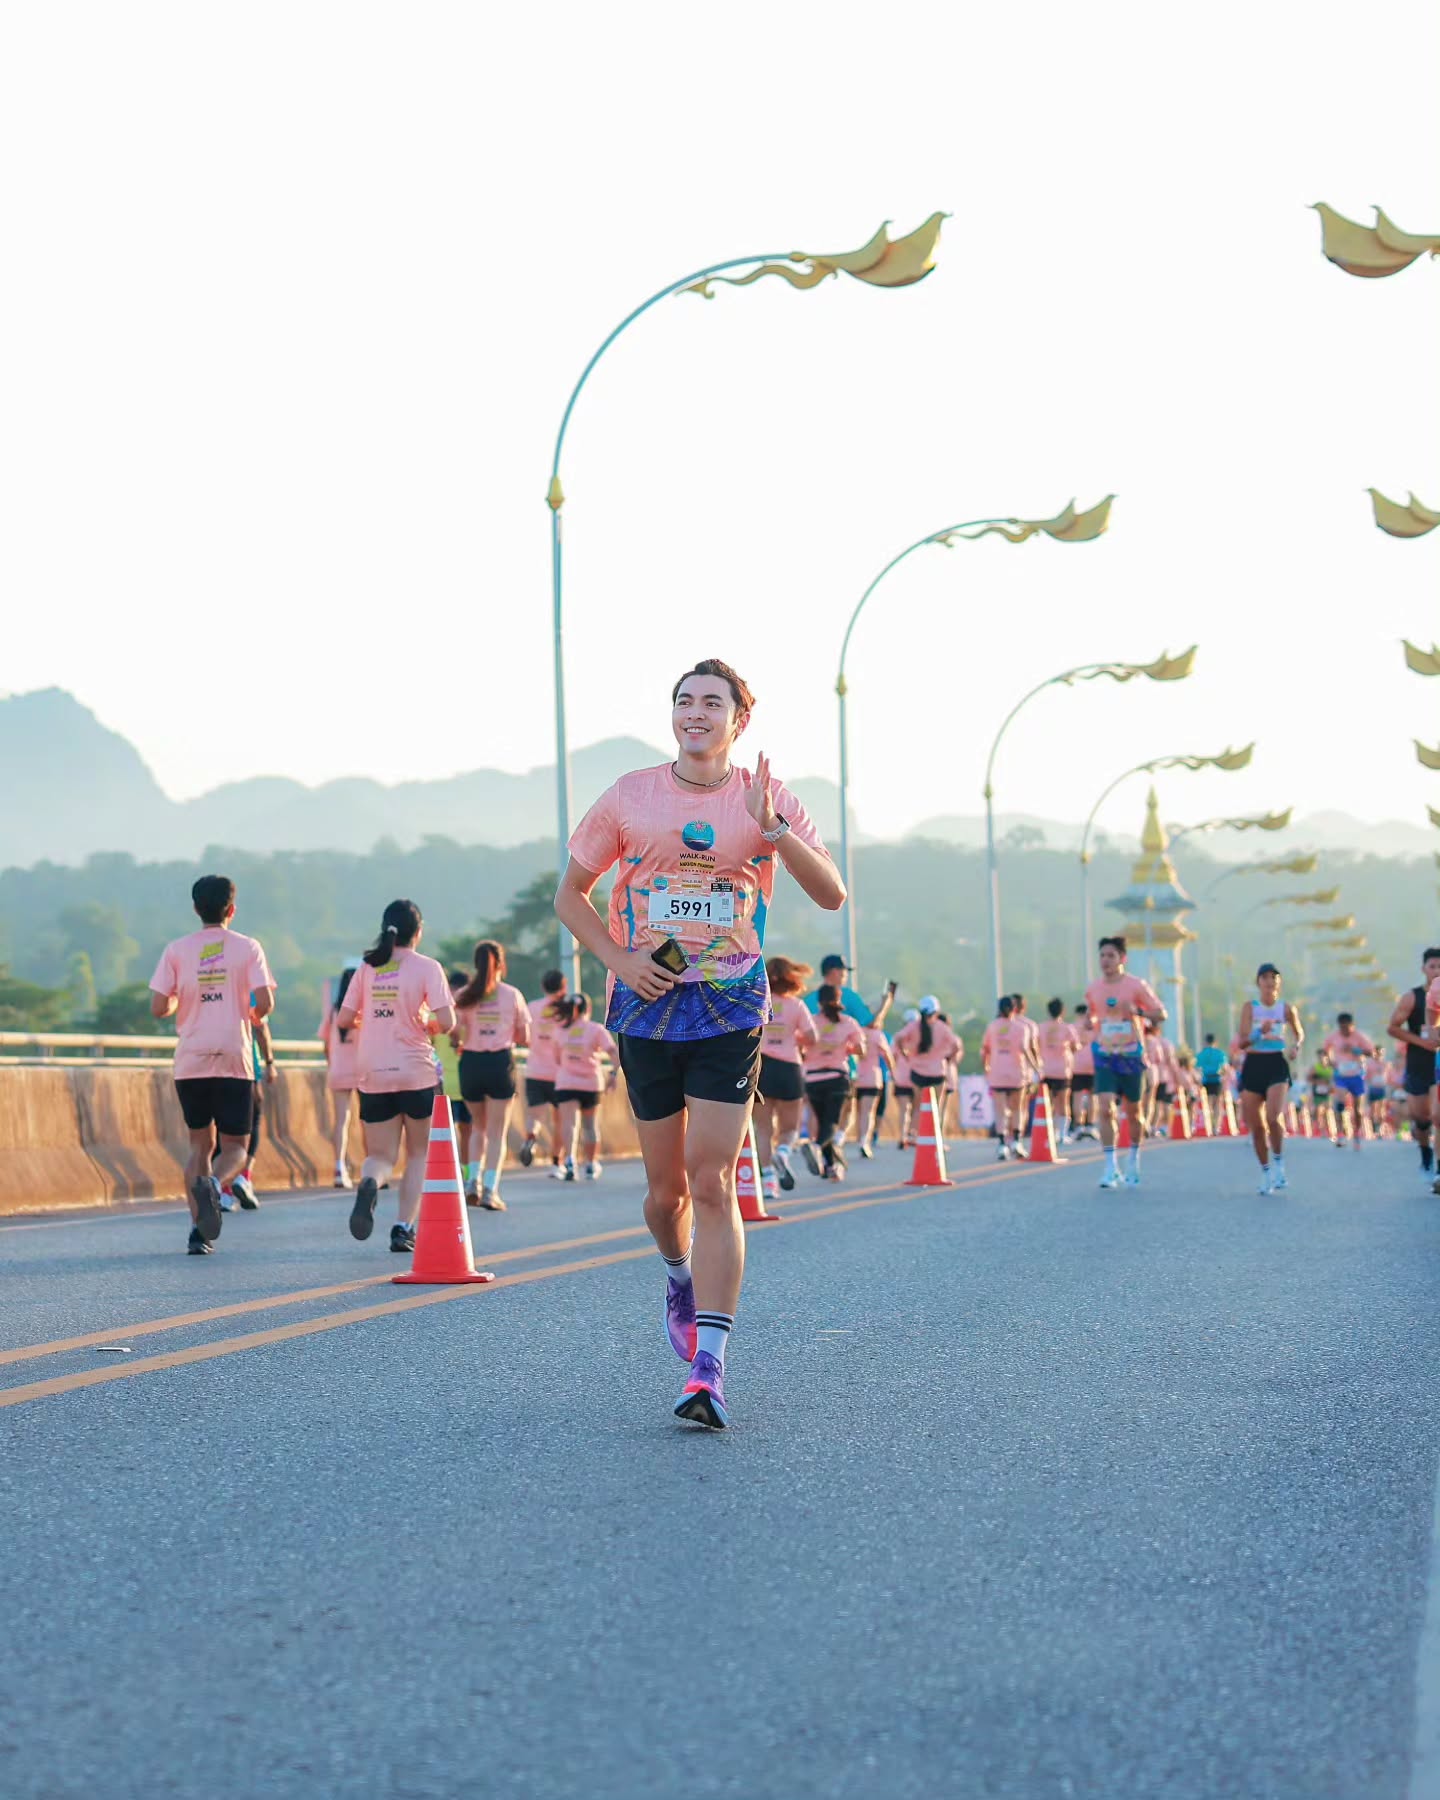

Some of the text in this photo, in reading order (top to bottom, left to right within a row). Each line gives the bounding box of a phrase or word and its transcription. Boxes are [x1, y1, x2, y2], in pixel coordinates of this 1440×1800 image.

[680, 853, 716, 862] WALK-RUN
[670, 899, 711, 918] 5991
[201, 993, 223, 1003] 5KM
[374, 1009, 394, 1018] 5KM
[970, 1091, 984, 1111] 2
